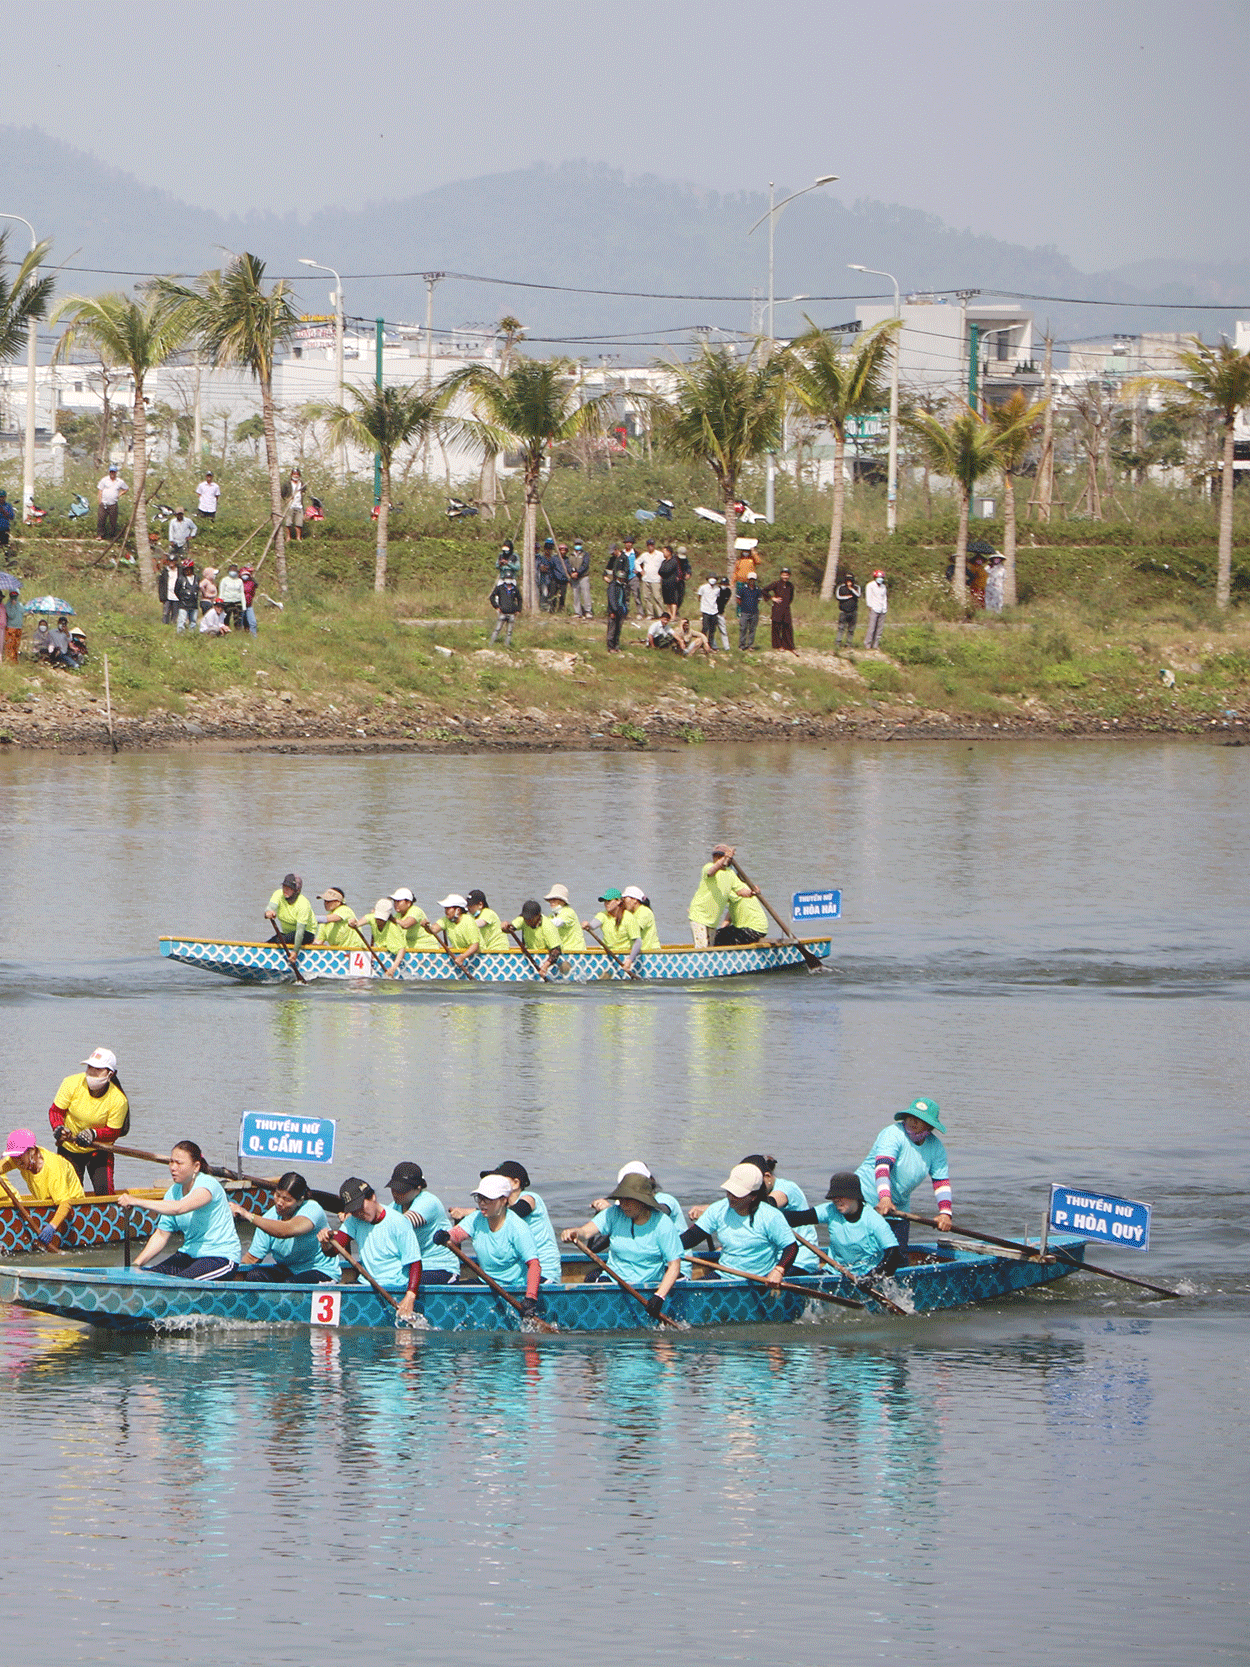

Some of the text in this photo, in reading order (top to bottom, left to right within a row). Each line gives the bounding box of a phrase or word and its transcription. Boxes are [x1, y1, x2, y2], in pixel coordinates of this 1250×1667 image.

[794, 906, 802, 916] P.
[802, 903, 820, 915] HÒA
[354, 953, 364, 969] 4
[255, 1119, 321, 1134] THUYỀN NỮ
[249, 1133, 325, 1158] Q. CẨM LỆ
[1065, 1195, 1134, 1218] THUYỀN NỮ
[1055, 1210, 1144, 1241] P. HÒA QUÝ
[317, 1295, 334, 1323] 3
